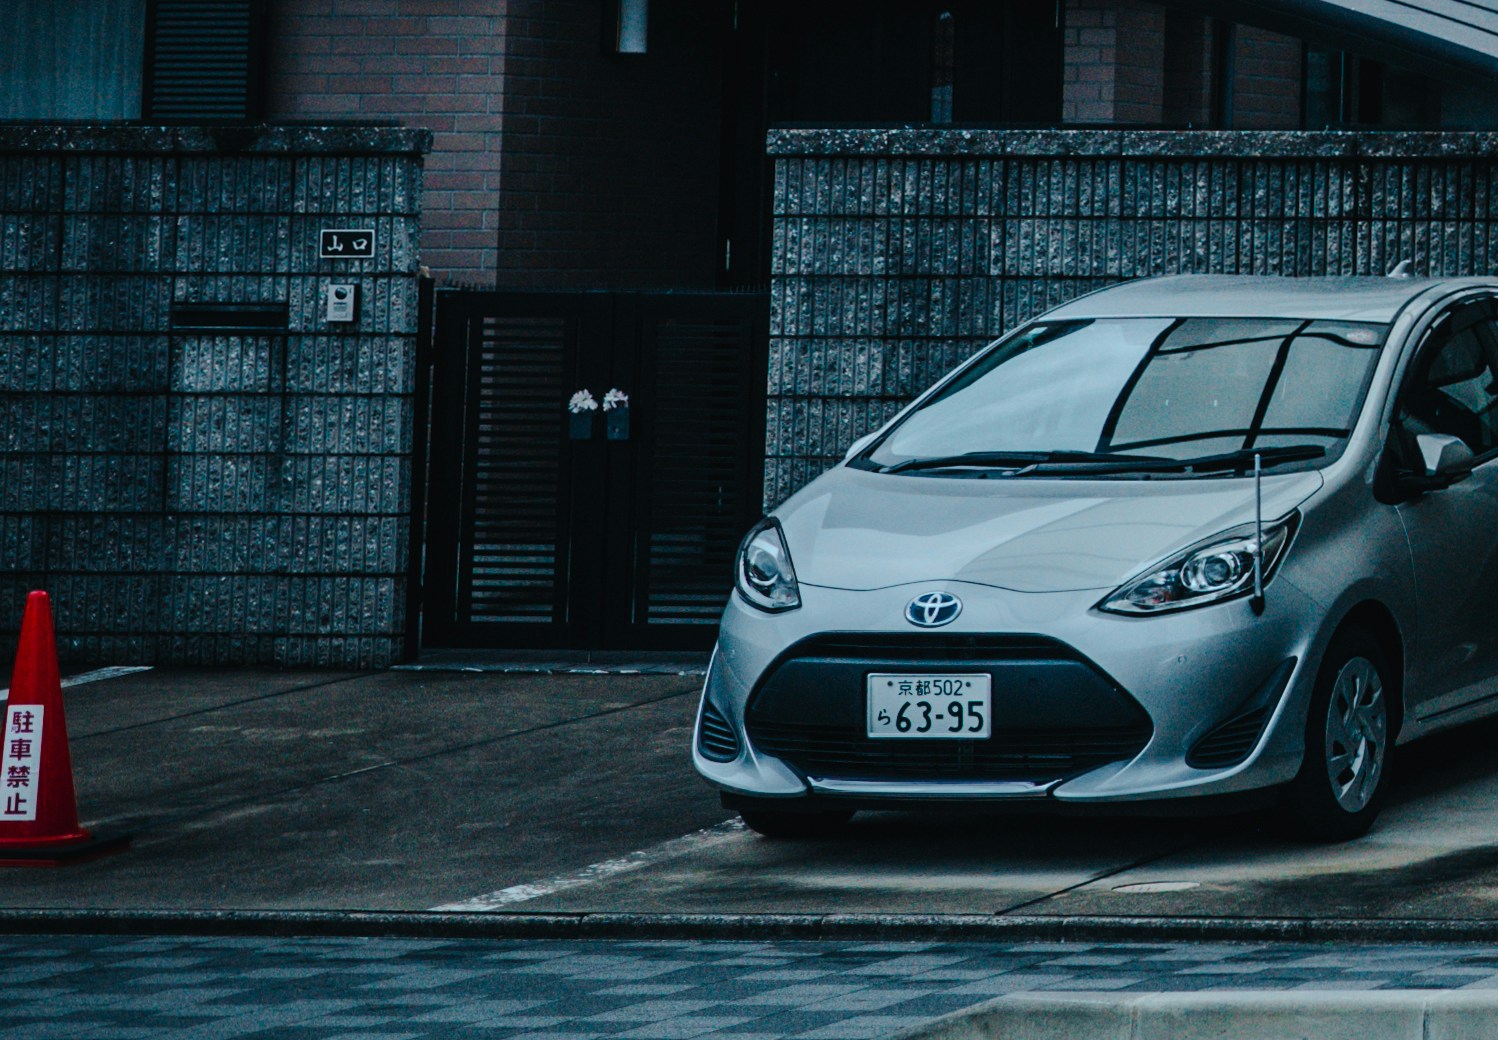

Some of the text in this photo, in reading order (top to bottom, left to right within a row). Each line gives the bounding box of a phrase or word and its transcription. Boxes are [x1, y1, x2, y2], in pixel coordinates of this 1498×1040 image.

[327, 235, 368, 251] 山口
[877, 700, 984, 733] ら 63-95
[4, 710, 34, 815] 駐車禁止
